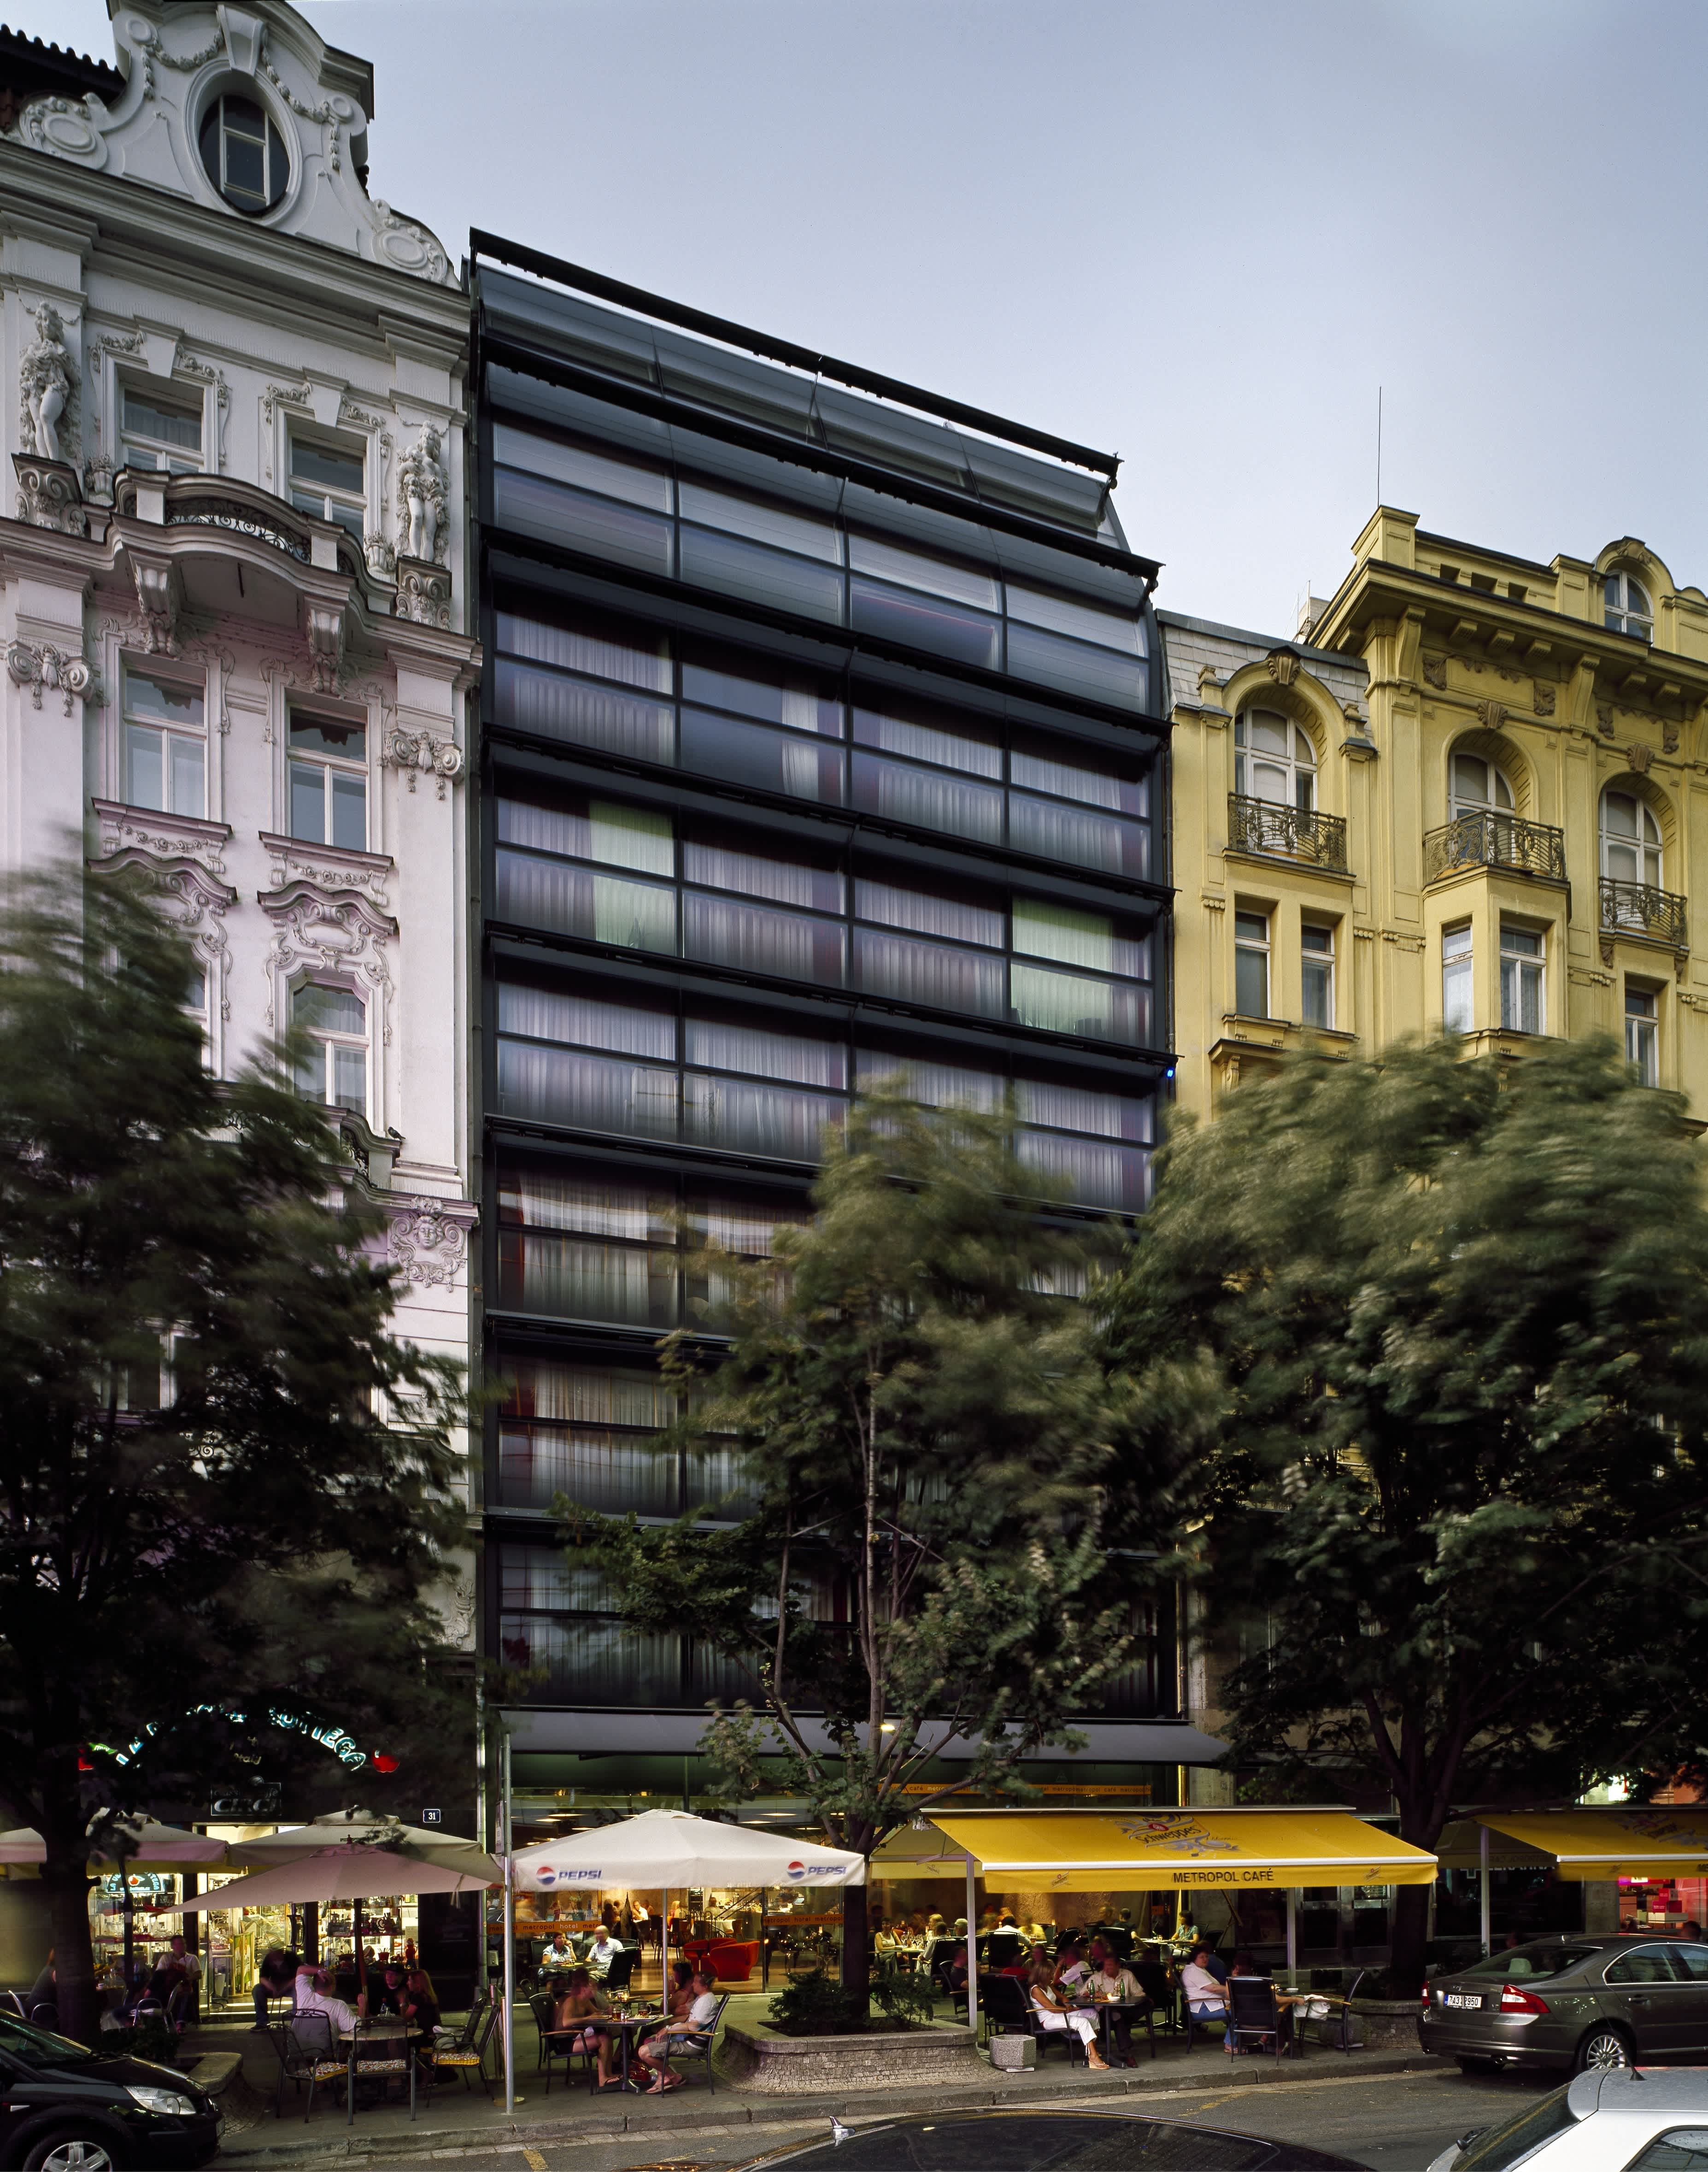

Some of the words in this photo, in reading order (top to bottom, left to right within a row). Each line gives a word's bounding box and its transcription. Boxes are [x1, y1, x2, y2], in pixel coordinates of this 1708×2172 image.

[1135, 1825, 1202, 1843] Schweppes
[558, 1870, 602, 1880] PEPSI
[807, 1866, 847, 1875] PEPSI
[1173, 1871, 1239, 1883] METROPOL
[1243, 1868, 1274, 1881] CAFÉ
